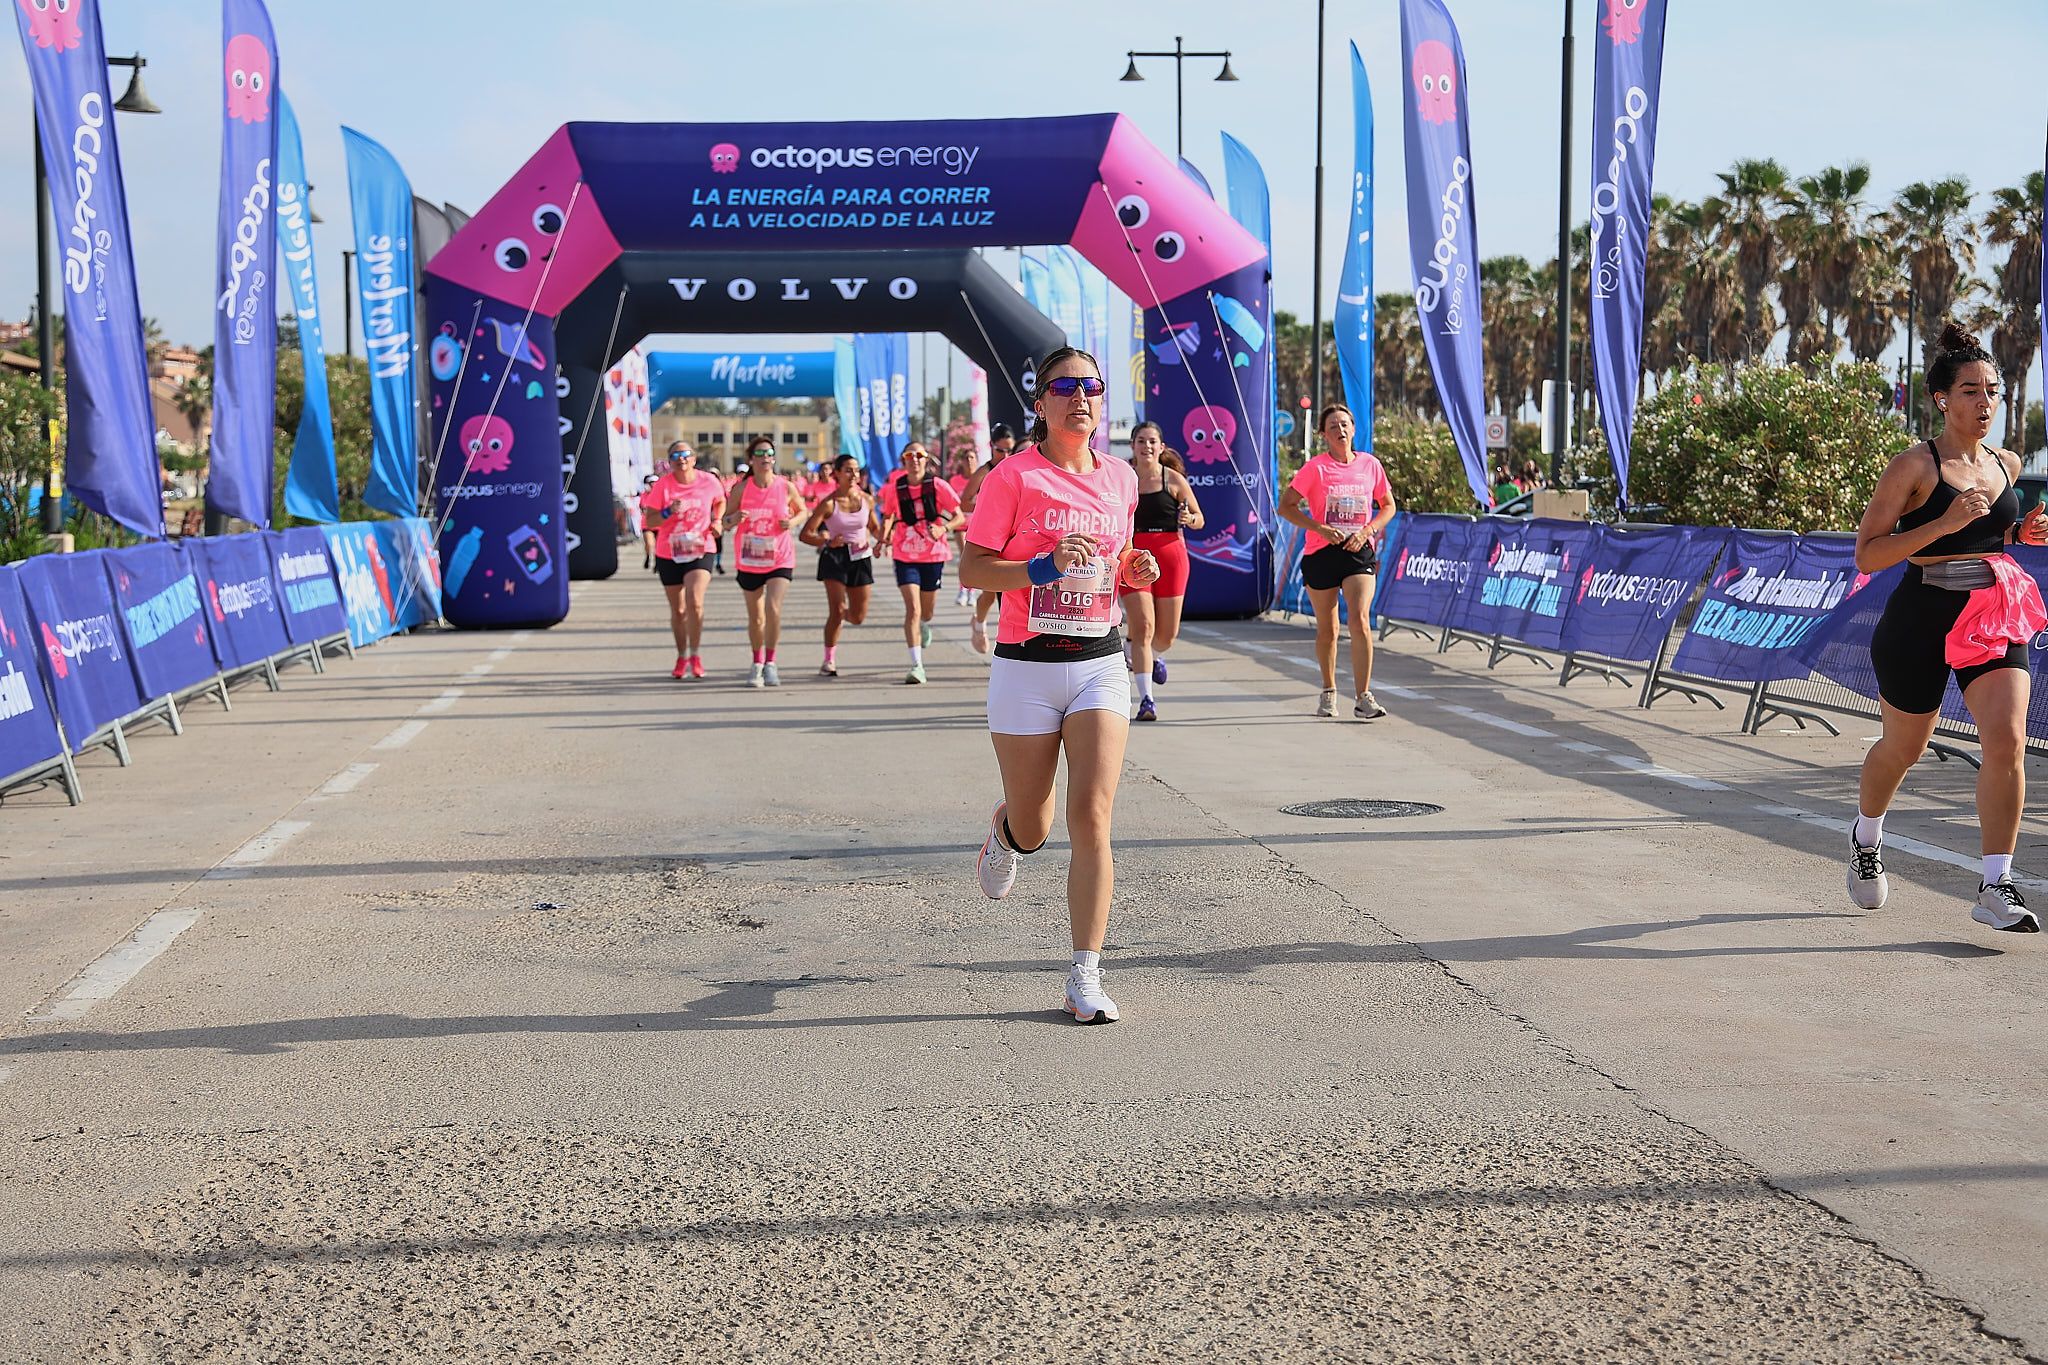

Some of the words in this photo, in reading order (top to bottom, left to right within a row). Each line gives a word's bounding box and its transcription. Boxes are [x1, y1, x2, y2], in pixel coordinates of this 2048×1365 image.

[750, 145, 874, 174] octopus
[876, 145, 980, 175] energy
[692, 188, 721, 205] LA
[727, 184, 825, 205] ENERGÍA
[831, 188, 892, 205] PARA
[899, 187, 991, 205] CORRER
[689, 213, 706, 228] A
[712, 213, 741, 228] LA
[748, 213, 877, 228] VELOCIDAD
[881, 212, 912, 228] DE
[916, 212, 945, 227] LA
[951, 211, 996, 226] LUZ
[668, 277, 918, 301] VOLVO
[711, 354, 797, 393] Marlene
[494, 482, 544, 499] energy
[1044, 508, 1119, 538] CARRERA
[1060, 591, 1093, 607] 016
[1588, 569, 1640, 607] octopus
[1633, 576, 1688, 619] energy
[1038, 621, 1067, 630] OYSHO
[1692, 598, 1775, 647] VELOCIDAD
[1759, 614, 1792, 649] DE
